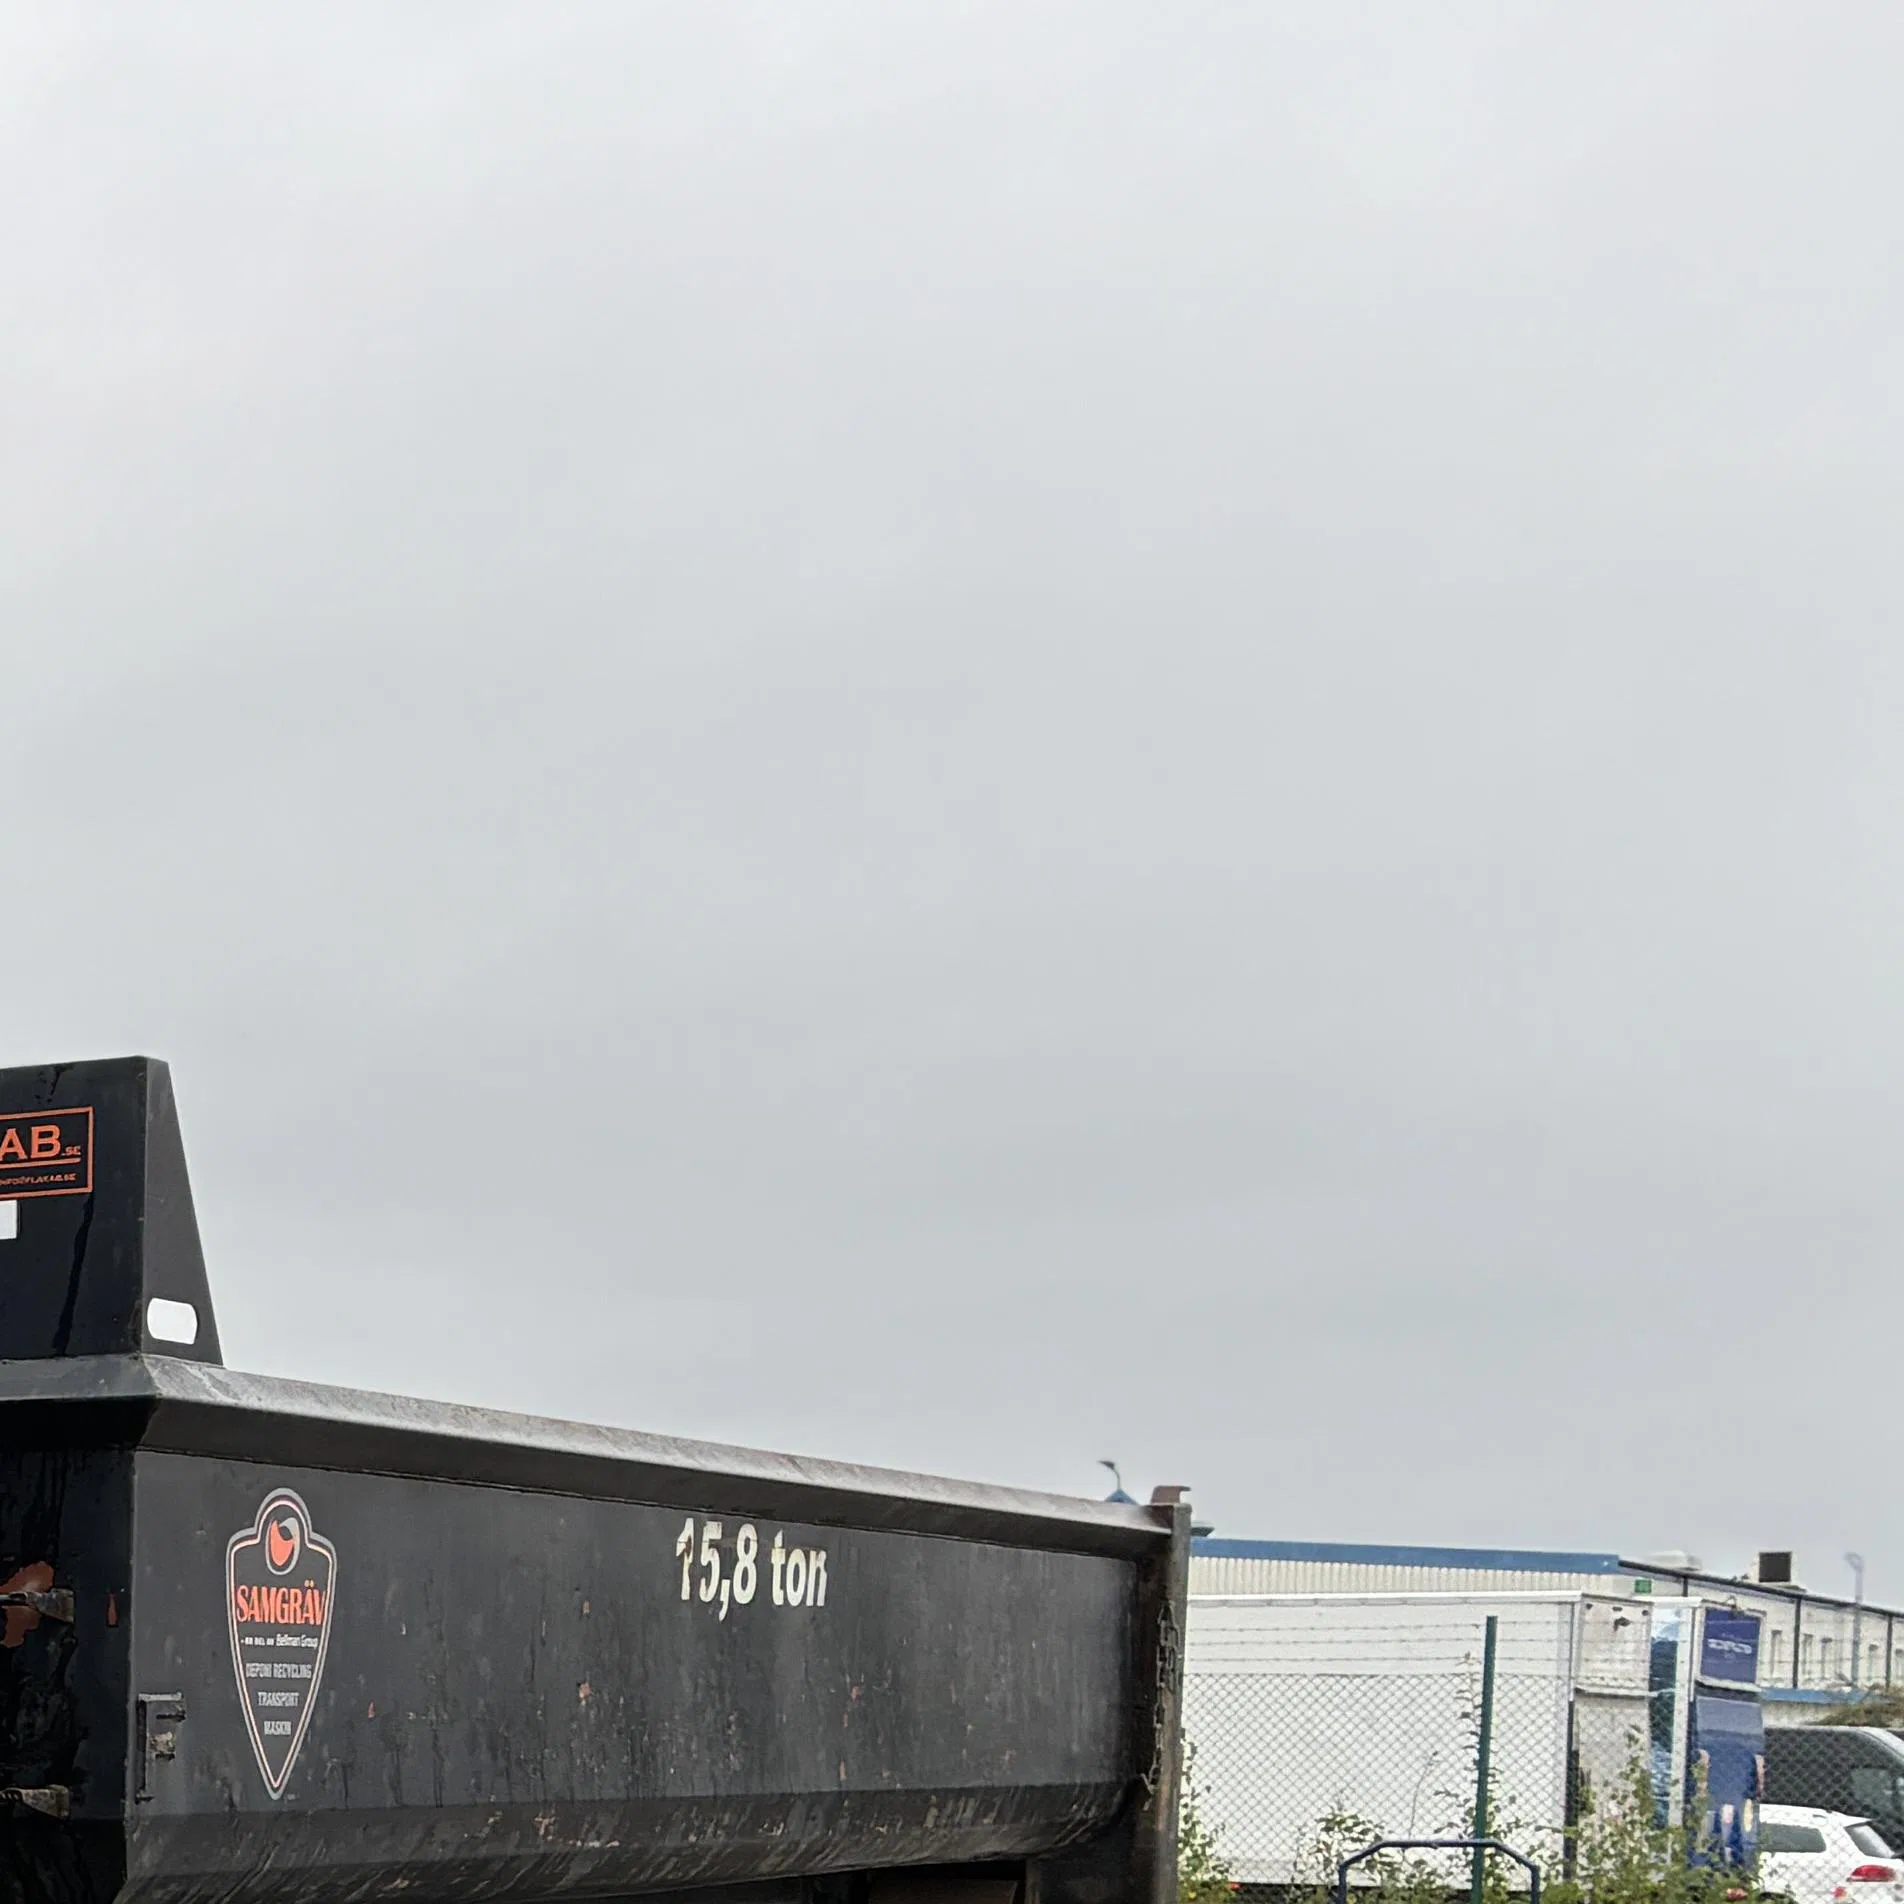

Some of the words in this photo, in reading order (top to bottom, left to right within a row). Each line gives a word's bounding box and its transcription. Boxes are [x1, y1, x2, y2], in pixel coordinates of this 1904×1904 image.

[676, 1517, 759, 1622] 15,8
[771, 1529, 828, 1607] ton
[236, 1579, 326, 1625] SAMGRÄV
[257, 1691, 299, 1707] TRANSPORT
